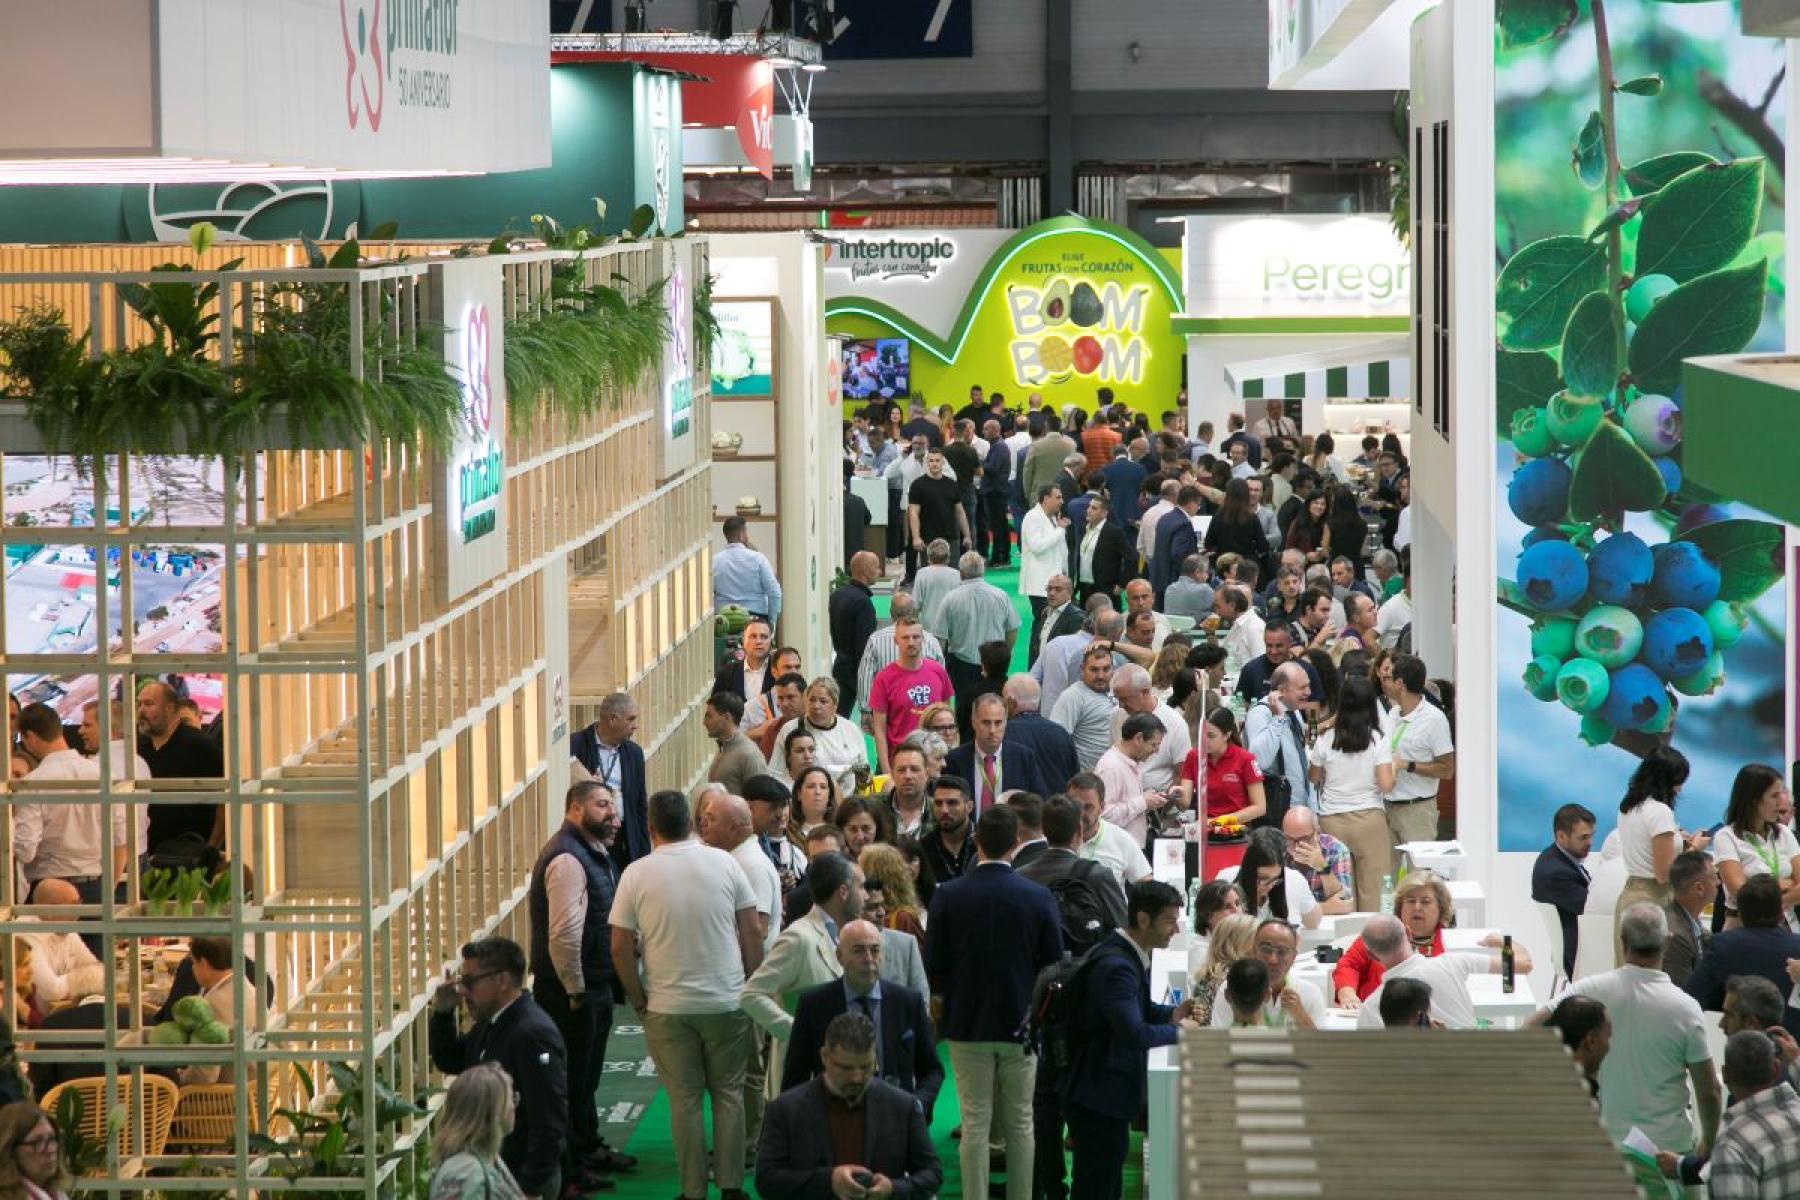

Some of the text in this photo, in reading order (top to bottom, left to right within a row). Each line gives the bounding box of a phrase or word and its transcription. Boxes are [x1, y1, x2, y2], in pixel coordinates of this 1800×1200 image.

[840, 237, 954, 263] intertropic
[1022, 263, 1061, 273] FRUTAS
[1081, 258, 1133, 273] CORAZÓN
